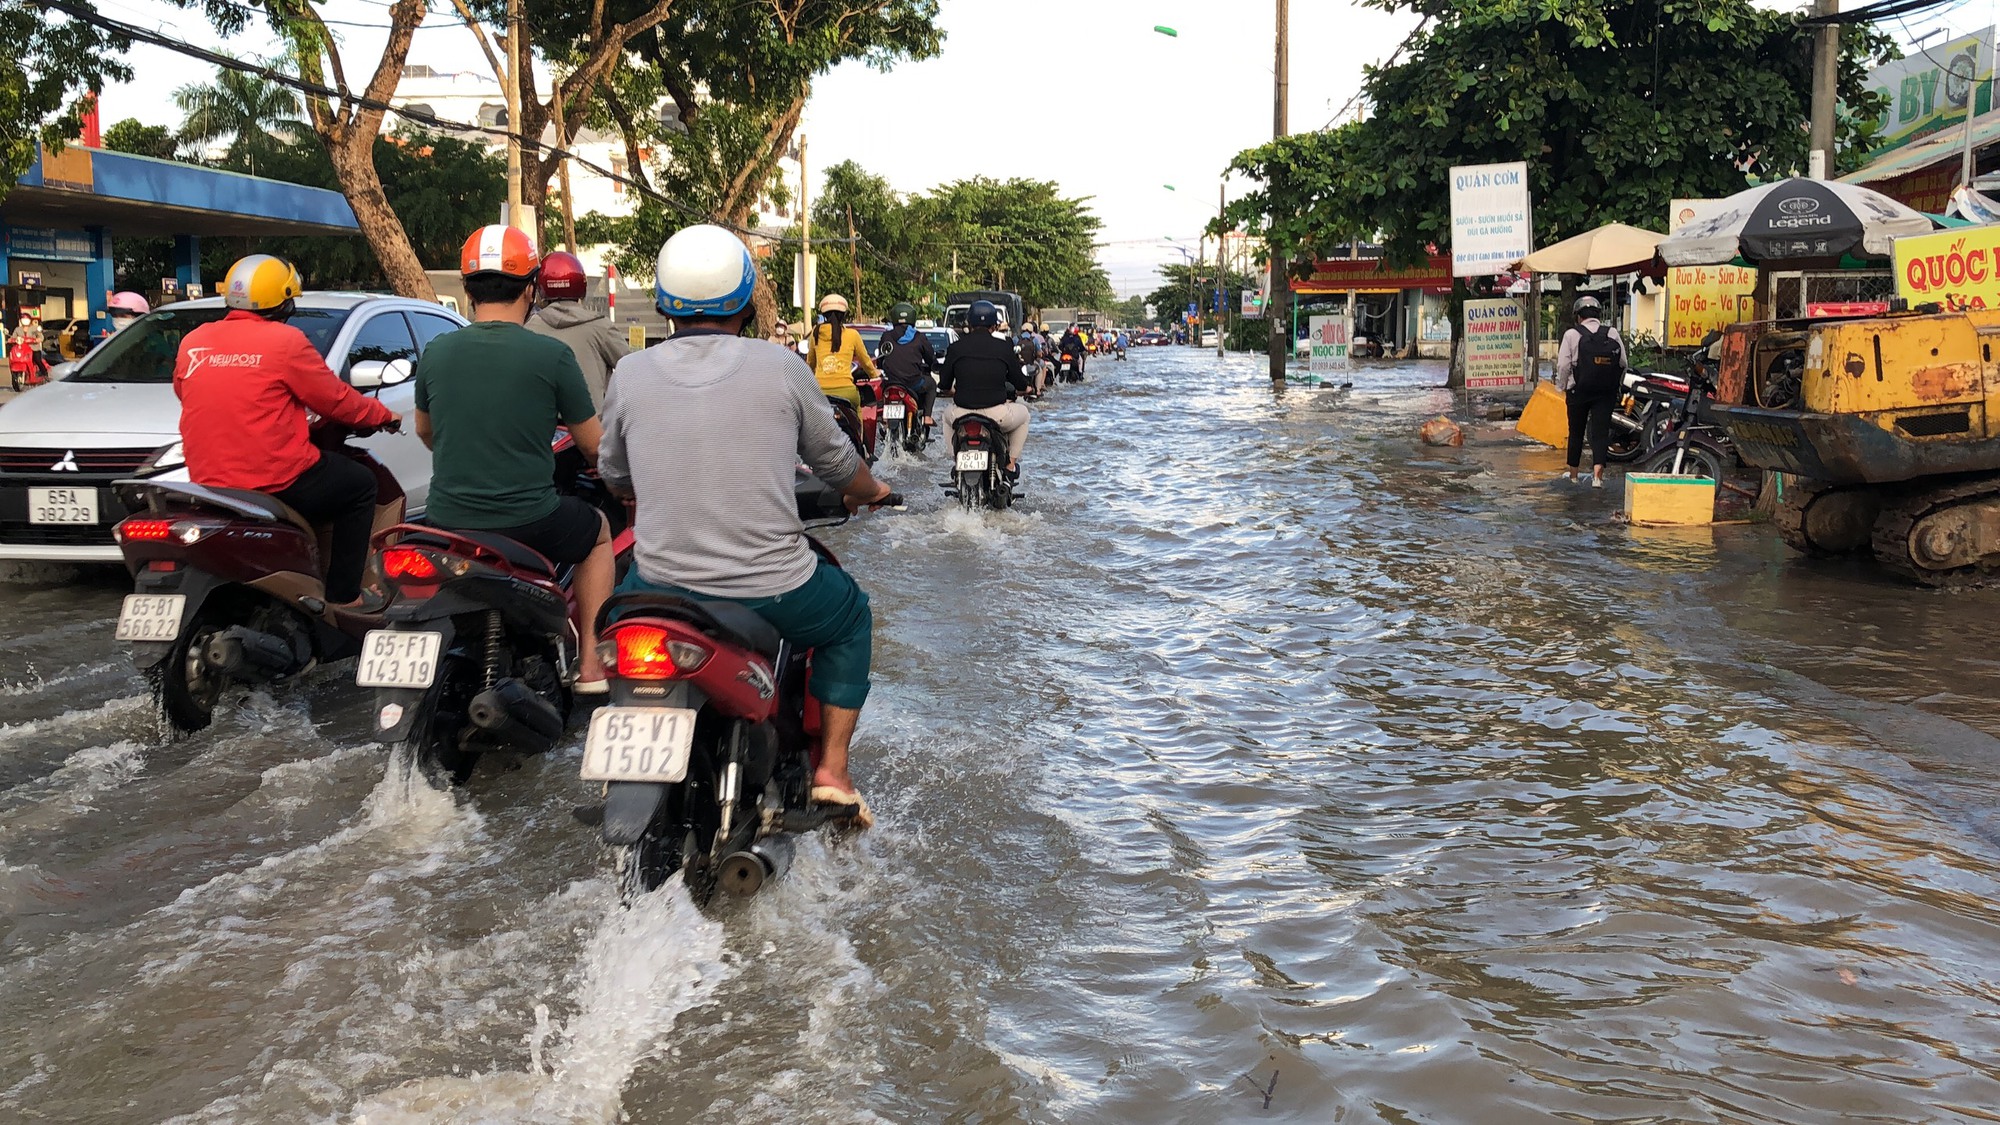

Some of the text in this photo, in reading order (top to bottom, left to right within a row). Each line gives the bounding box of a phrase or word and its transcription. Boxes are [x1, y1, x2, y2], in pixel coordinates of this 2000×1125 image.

[1899, 67, 1941, 125] BY
[1494, 170, 1519, 186] CƠM
[1768, 214, 1831, 228] Legend
[1907, 238, 1988, 293] QUỐC
[1695, 268, 1706, 284] Xe
[1737, 267, 1748, 284] Xe
[1498, 305, 1517, 317] CƠM
[1675, 294, 1691, 316] Tay
[1694, 294, 1706, 311] Ga
[1468, 318, 1520, 334] THANH BÌNH
[1674, 322, 1686, 338] Xe
[1690, 321, 1702, 338] Số
[208, 353, 262, 365] NEWPOST
[1312, 345, 1346, 359] NGỌC BY
[48, 490, 78, 504] 65A
[37, 507, 90, 521] 382.29
[132, 598, 174, 616] 65-B1
[120, 618, 176, 637] 566.22
[374, 634, 428, 658] 65-F1
[366, 659, 430, 682] 143.19
[606, 713, 678, 742] 65-V1
[604, 744, 673, 776] 1502
